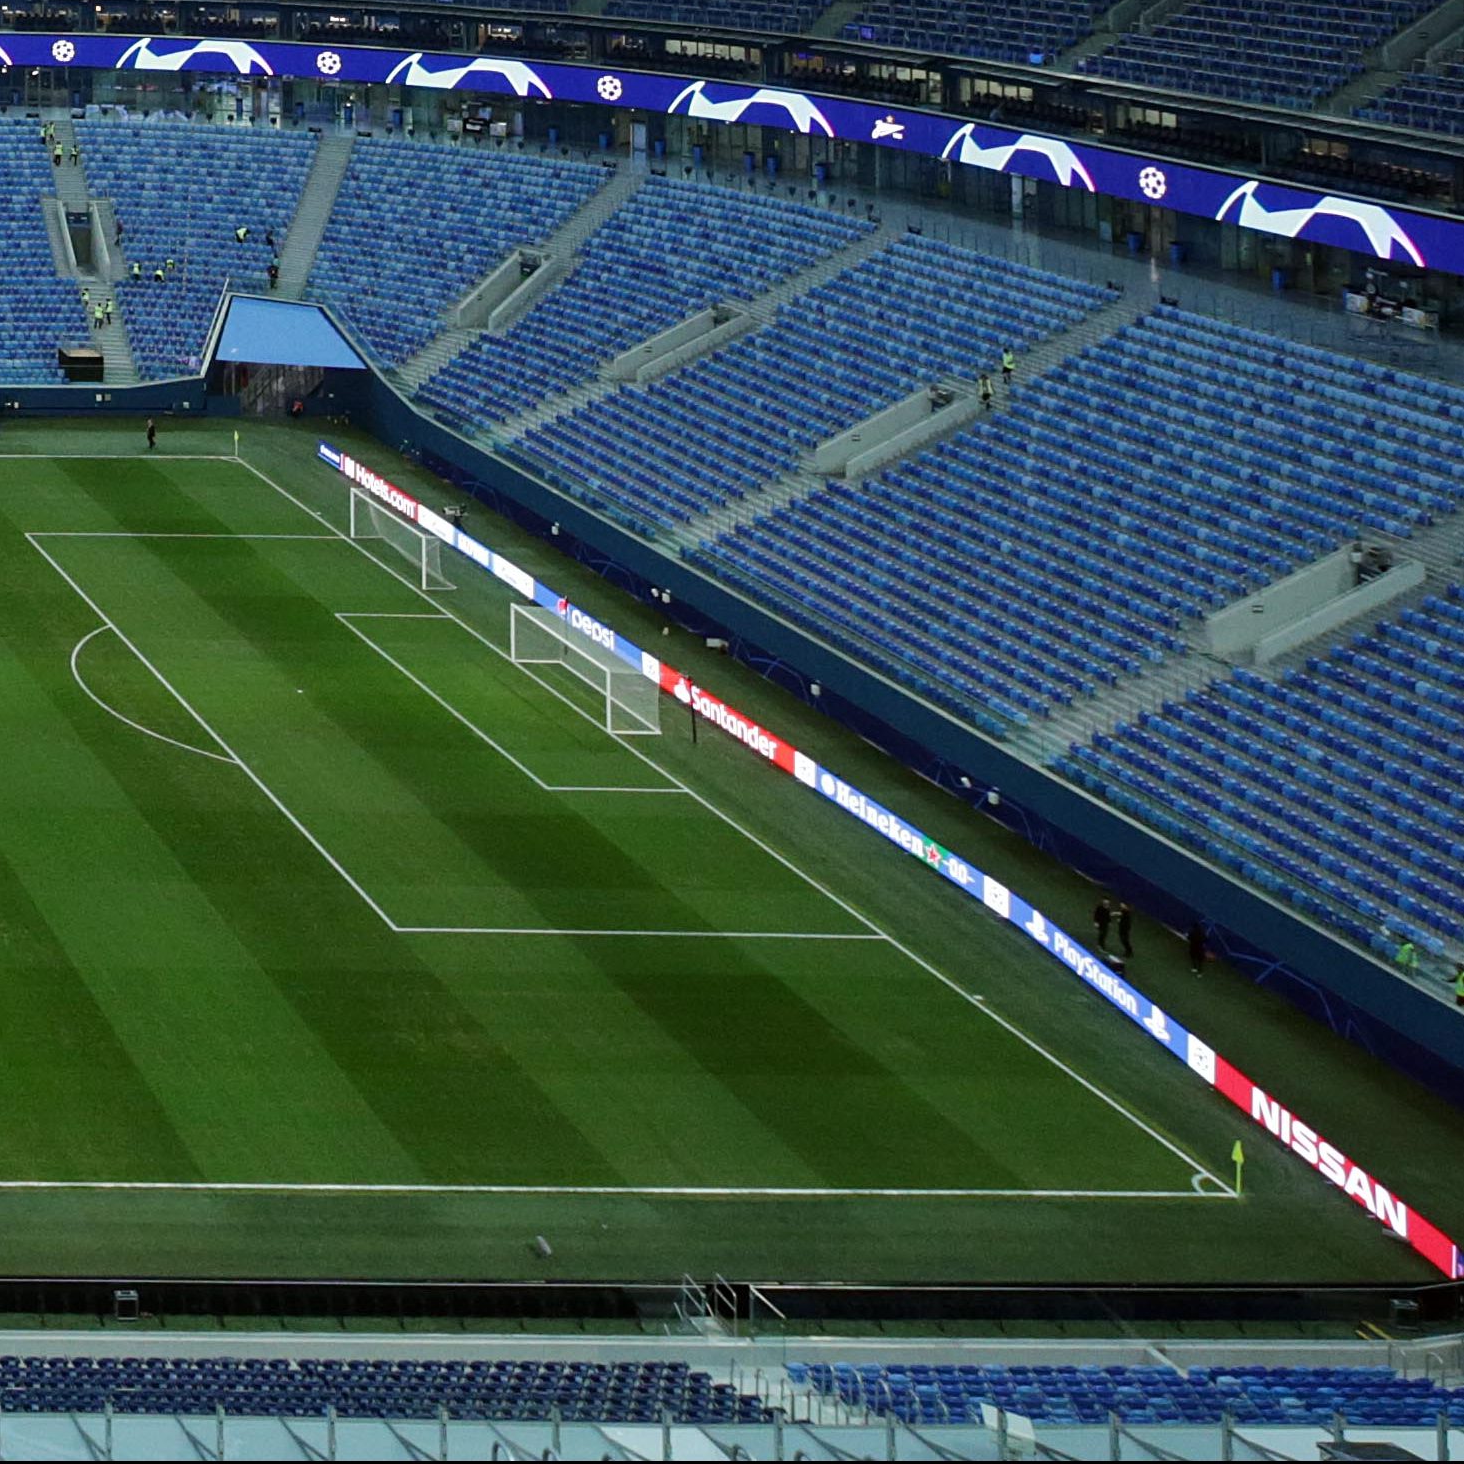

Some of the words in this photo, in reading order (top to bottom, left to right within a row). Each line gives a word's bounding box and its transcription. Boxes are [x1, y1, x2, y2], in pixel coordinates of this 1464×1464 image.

[356, 463, 417, 520] Hotels.com
[571, 609, 615, 651] pepsi
[691, 685, 777, 760] Santander
[836, 780, 925, 857] Heineken
[1054, 932, 1138, 1016] PlayStation
[1251, 1086, 1407, 1237] NISSAN
